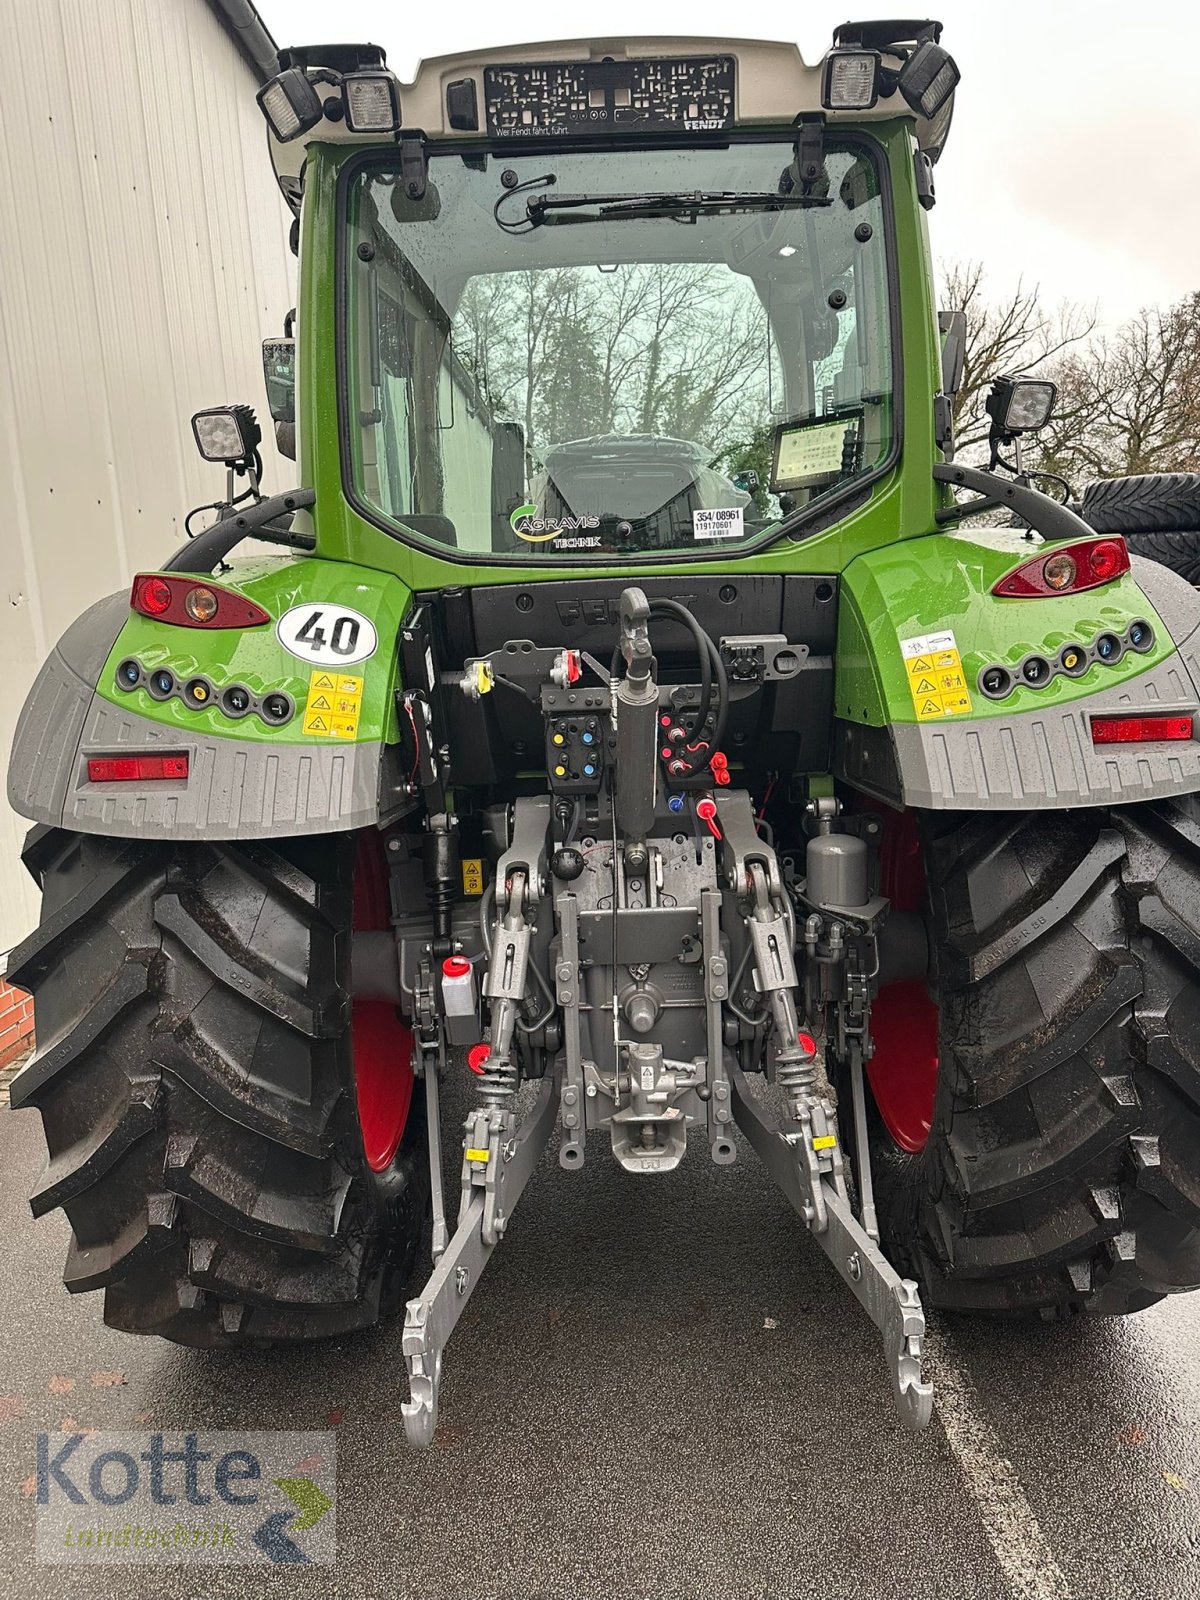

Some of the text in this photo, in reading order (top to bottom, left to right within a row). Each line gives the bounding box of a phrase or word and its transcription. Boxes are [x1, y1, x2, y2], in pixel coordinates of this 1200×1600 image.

[496, 128, 510, 136] Wer
[511, 127, 531, 136] Fendt
[683, 119, 726, 130] FENDT
[517, 515, 601, 532] AGRAVIS
[553, 536, 602, 548] TECHNIK
[555, 595, 698, 627] FET
[294, 611, 361, 656] 40
